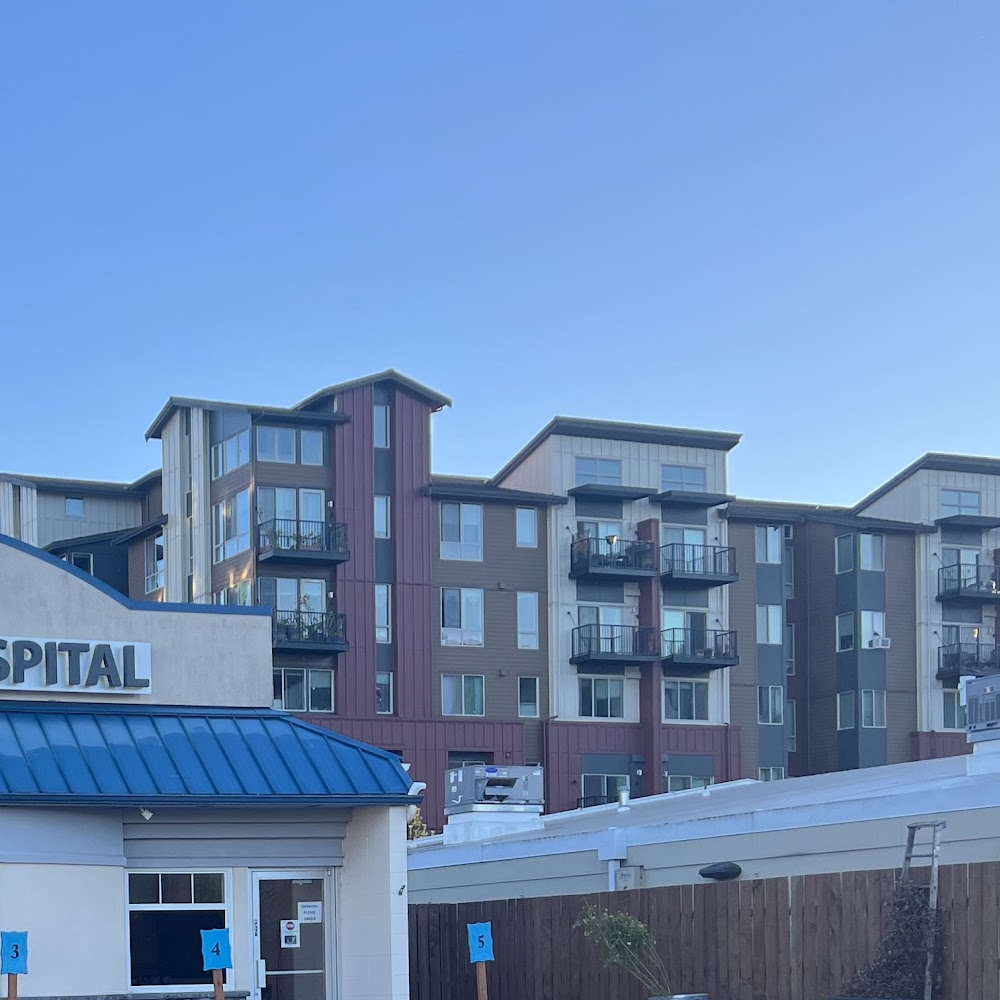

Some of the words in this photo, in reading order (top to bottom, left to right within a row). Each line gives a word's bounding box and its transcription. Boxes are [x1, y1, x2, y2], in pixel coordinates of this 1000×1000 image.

[211, 942, 220, 956] 4
[478, 935, 485, 949] 5
[11, 944, 19, 959] 3
